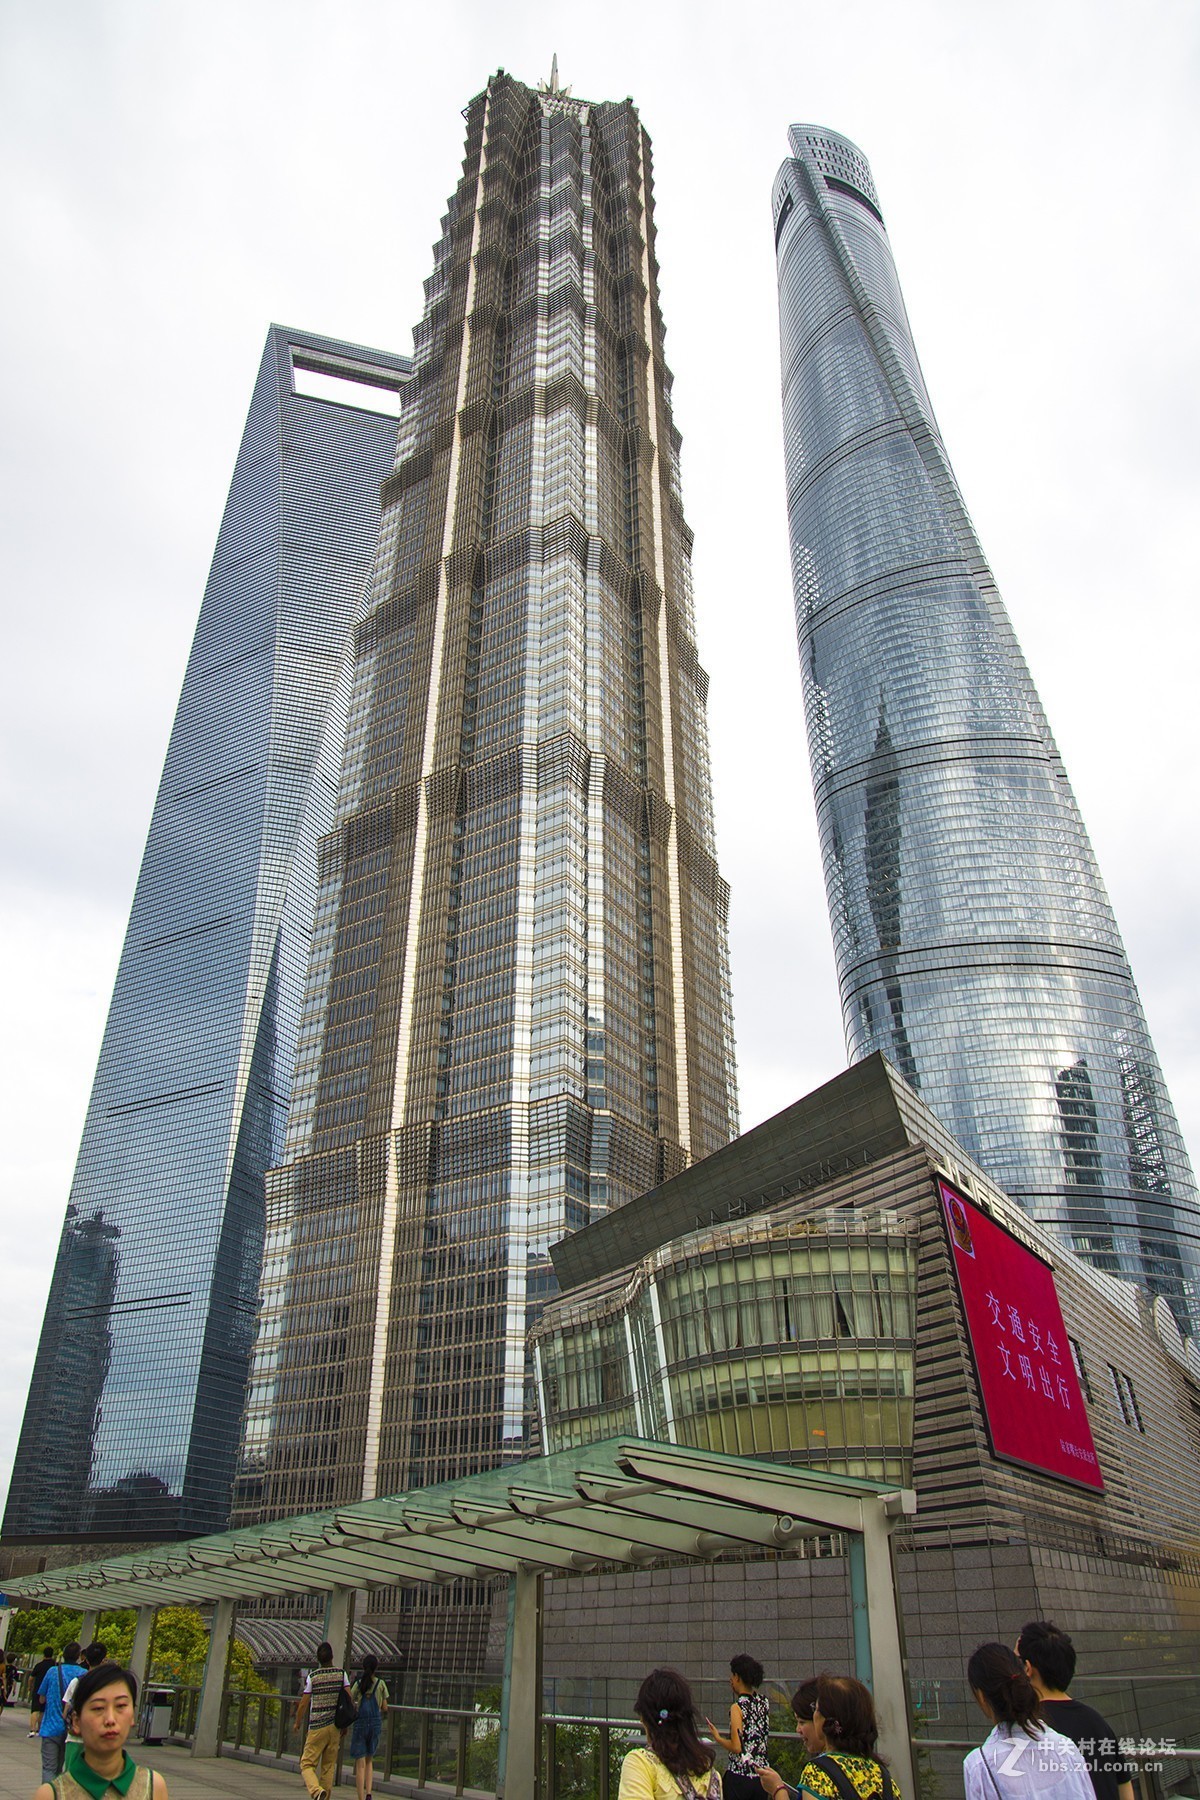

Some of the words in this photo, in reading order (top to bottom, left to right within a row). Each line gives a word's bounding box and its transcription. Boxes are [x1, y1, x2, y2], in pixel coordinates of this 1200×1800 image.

[985, 1290, 1062, 1365] 交通安全
[997, 1340, 1070, 1410] 文明出行
